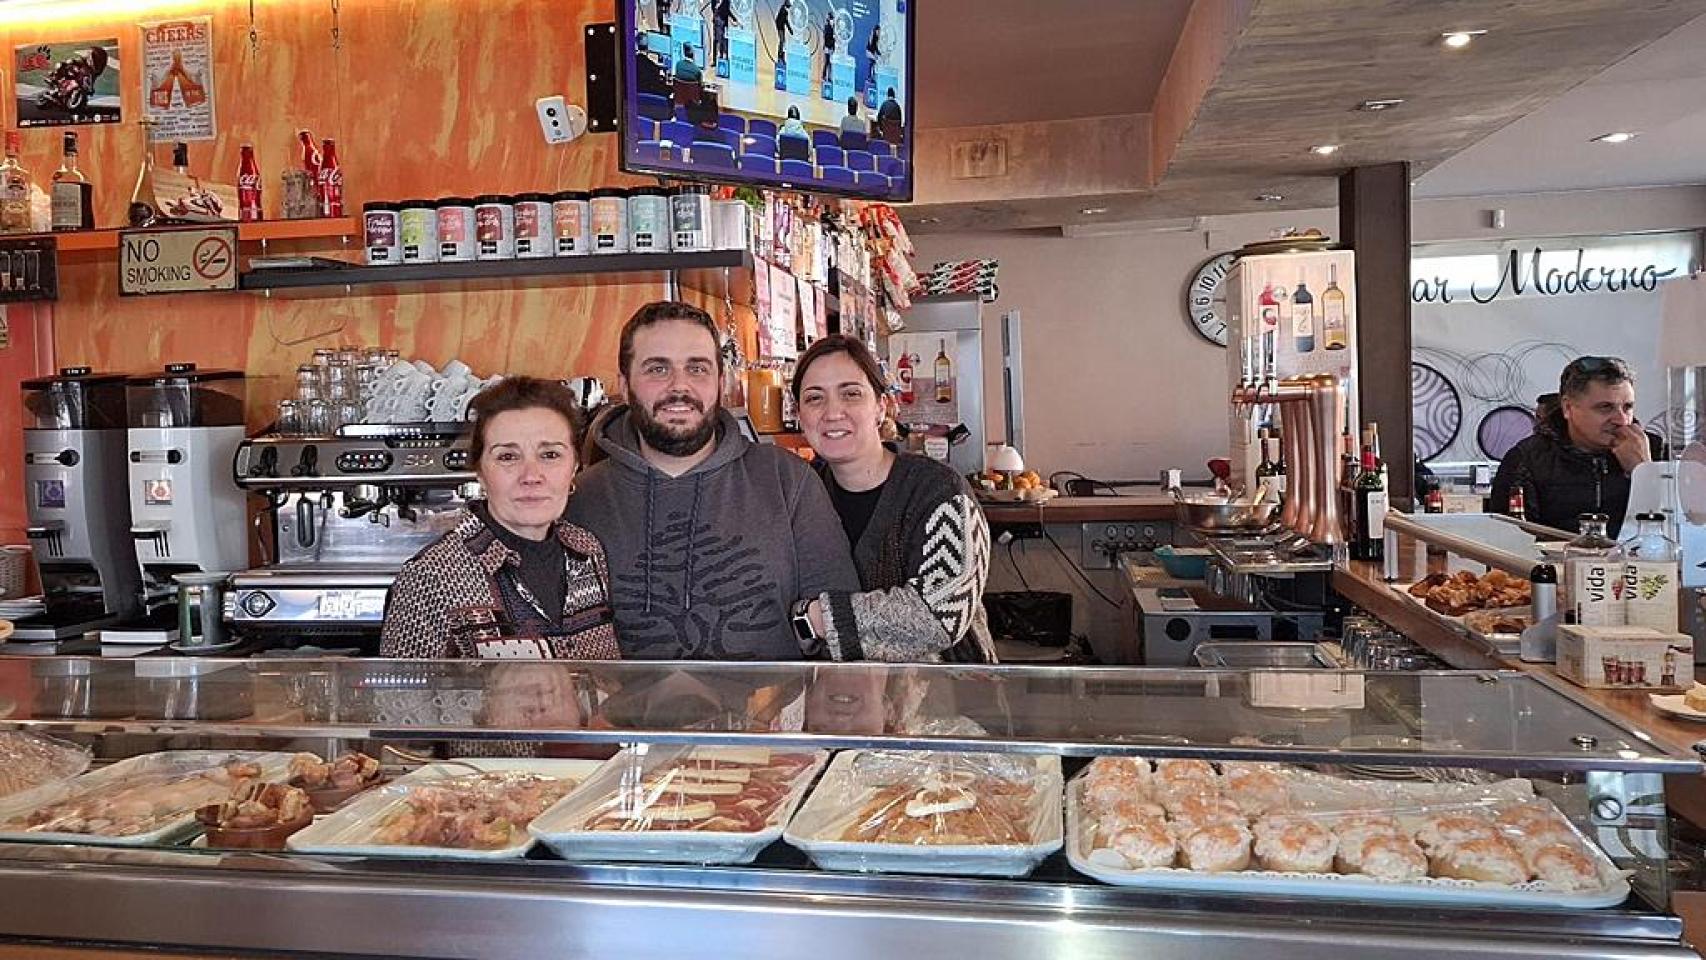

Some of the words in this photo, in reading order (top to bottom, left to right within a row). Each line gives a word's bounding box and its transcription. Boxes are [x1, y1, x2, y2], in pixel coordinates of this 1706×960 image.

[146, 26, 204, 43] CHEERS
[127, 239, 160, 263] NO
[127, 265, 191, 285] SMOKING
[1200, 276, 1216, 291] 10
[1412, 275, 1453, 304] ar
[1471, 247, 1677, 304] Moderno
[1201, 311, 1214, 324] 8
[1585, 567, 1605, 602] vida
[1620, 564, 1637, 600] vida
